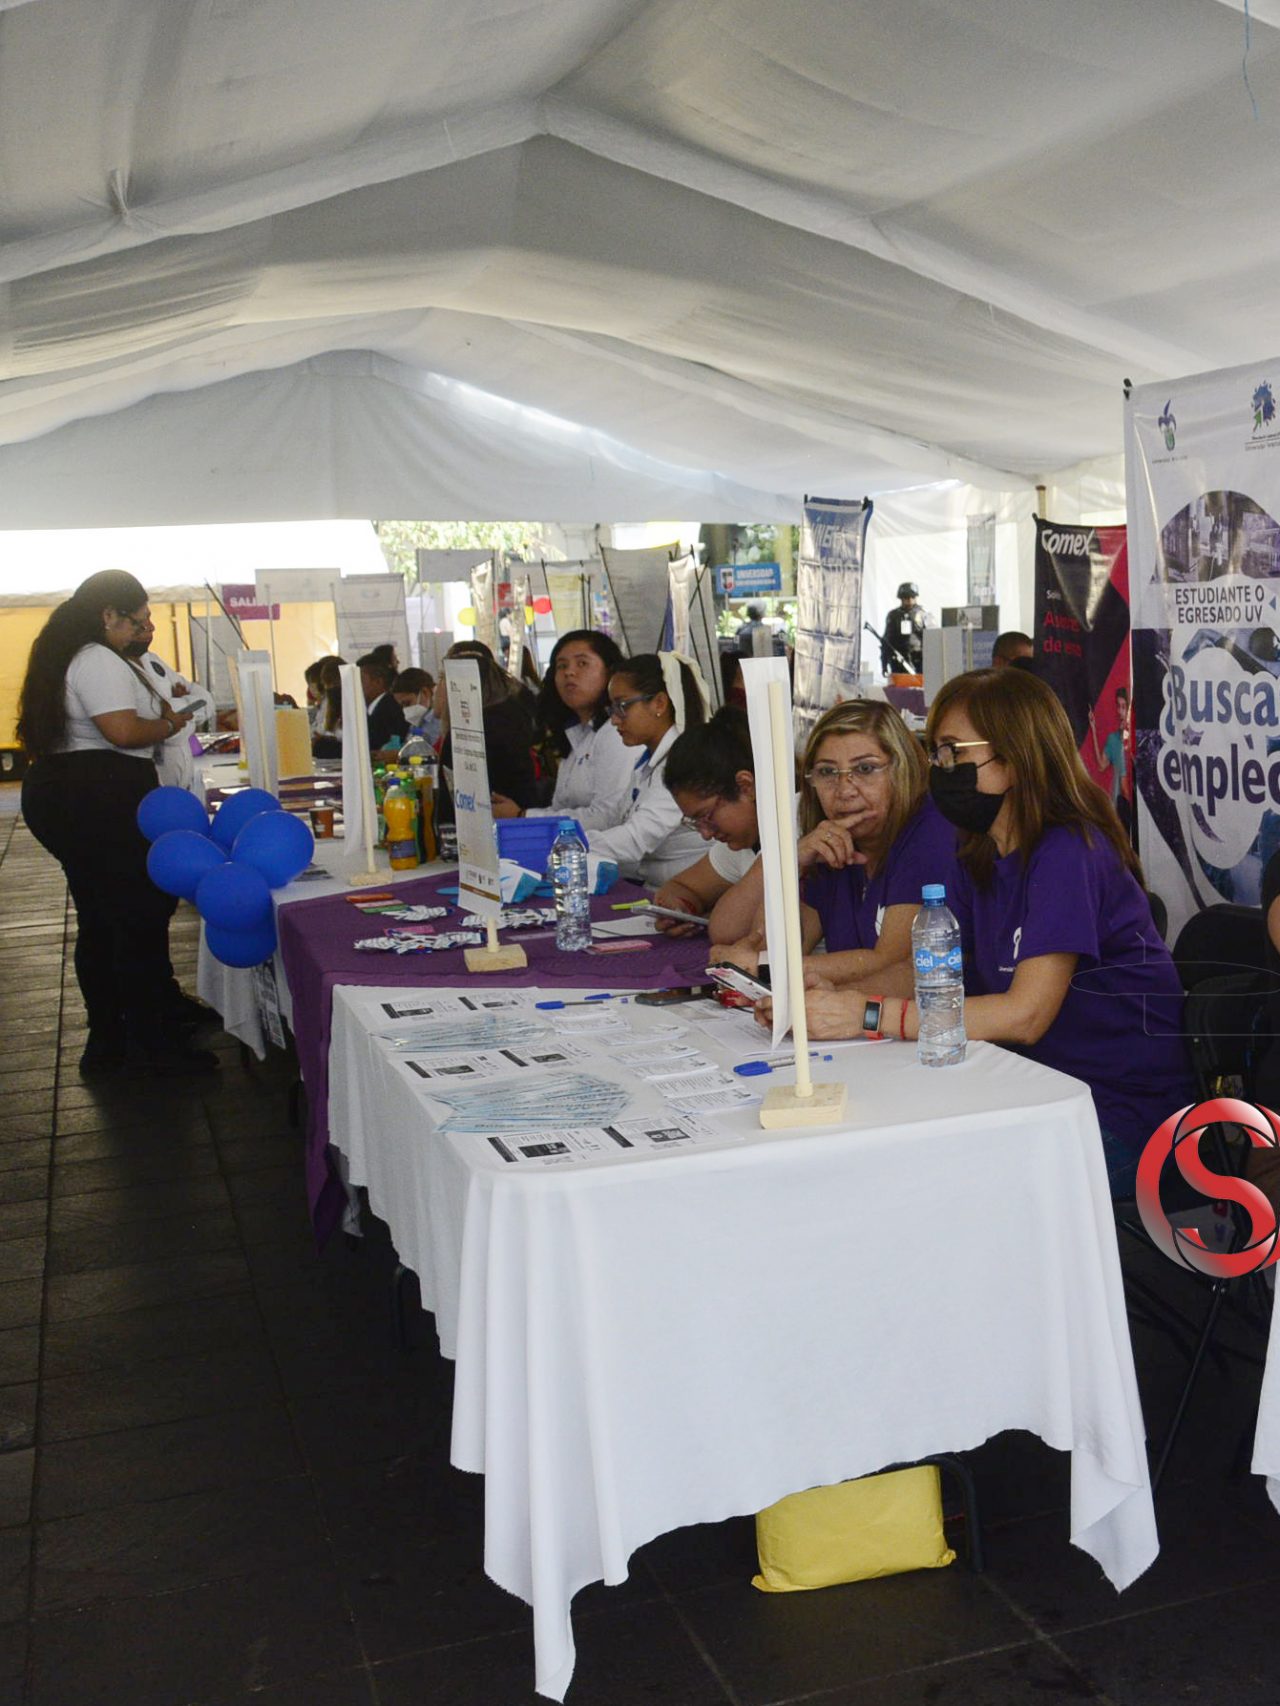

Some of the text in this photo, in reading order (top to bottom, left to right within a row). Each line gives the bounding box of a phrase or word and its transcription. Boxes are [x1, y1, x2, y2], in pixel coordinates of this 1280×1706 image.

[1041, 529, 1095, 557] Comex
[1175, 584, 1265, 605] ESTUDIANTE O
[1178, 605, 1263, 624] EGRESADO UV
[916, 954, 933, 967] ciel
